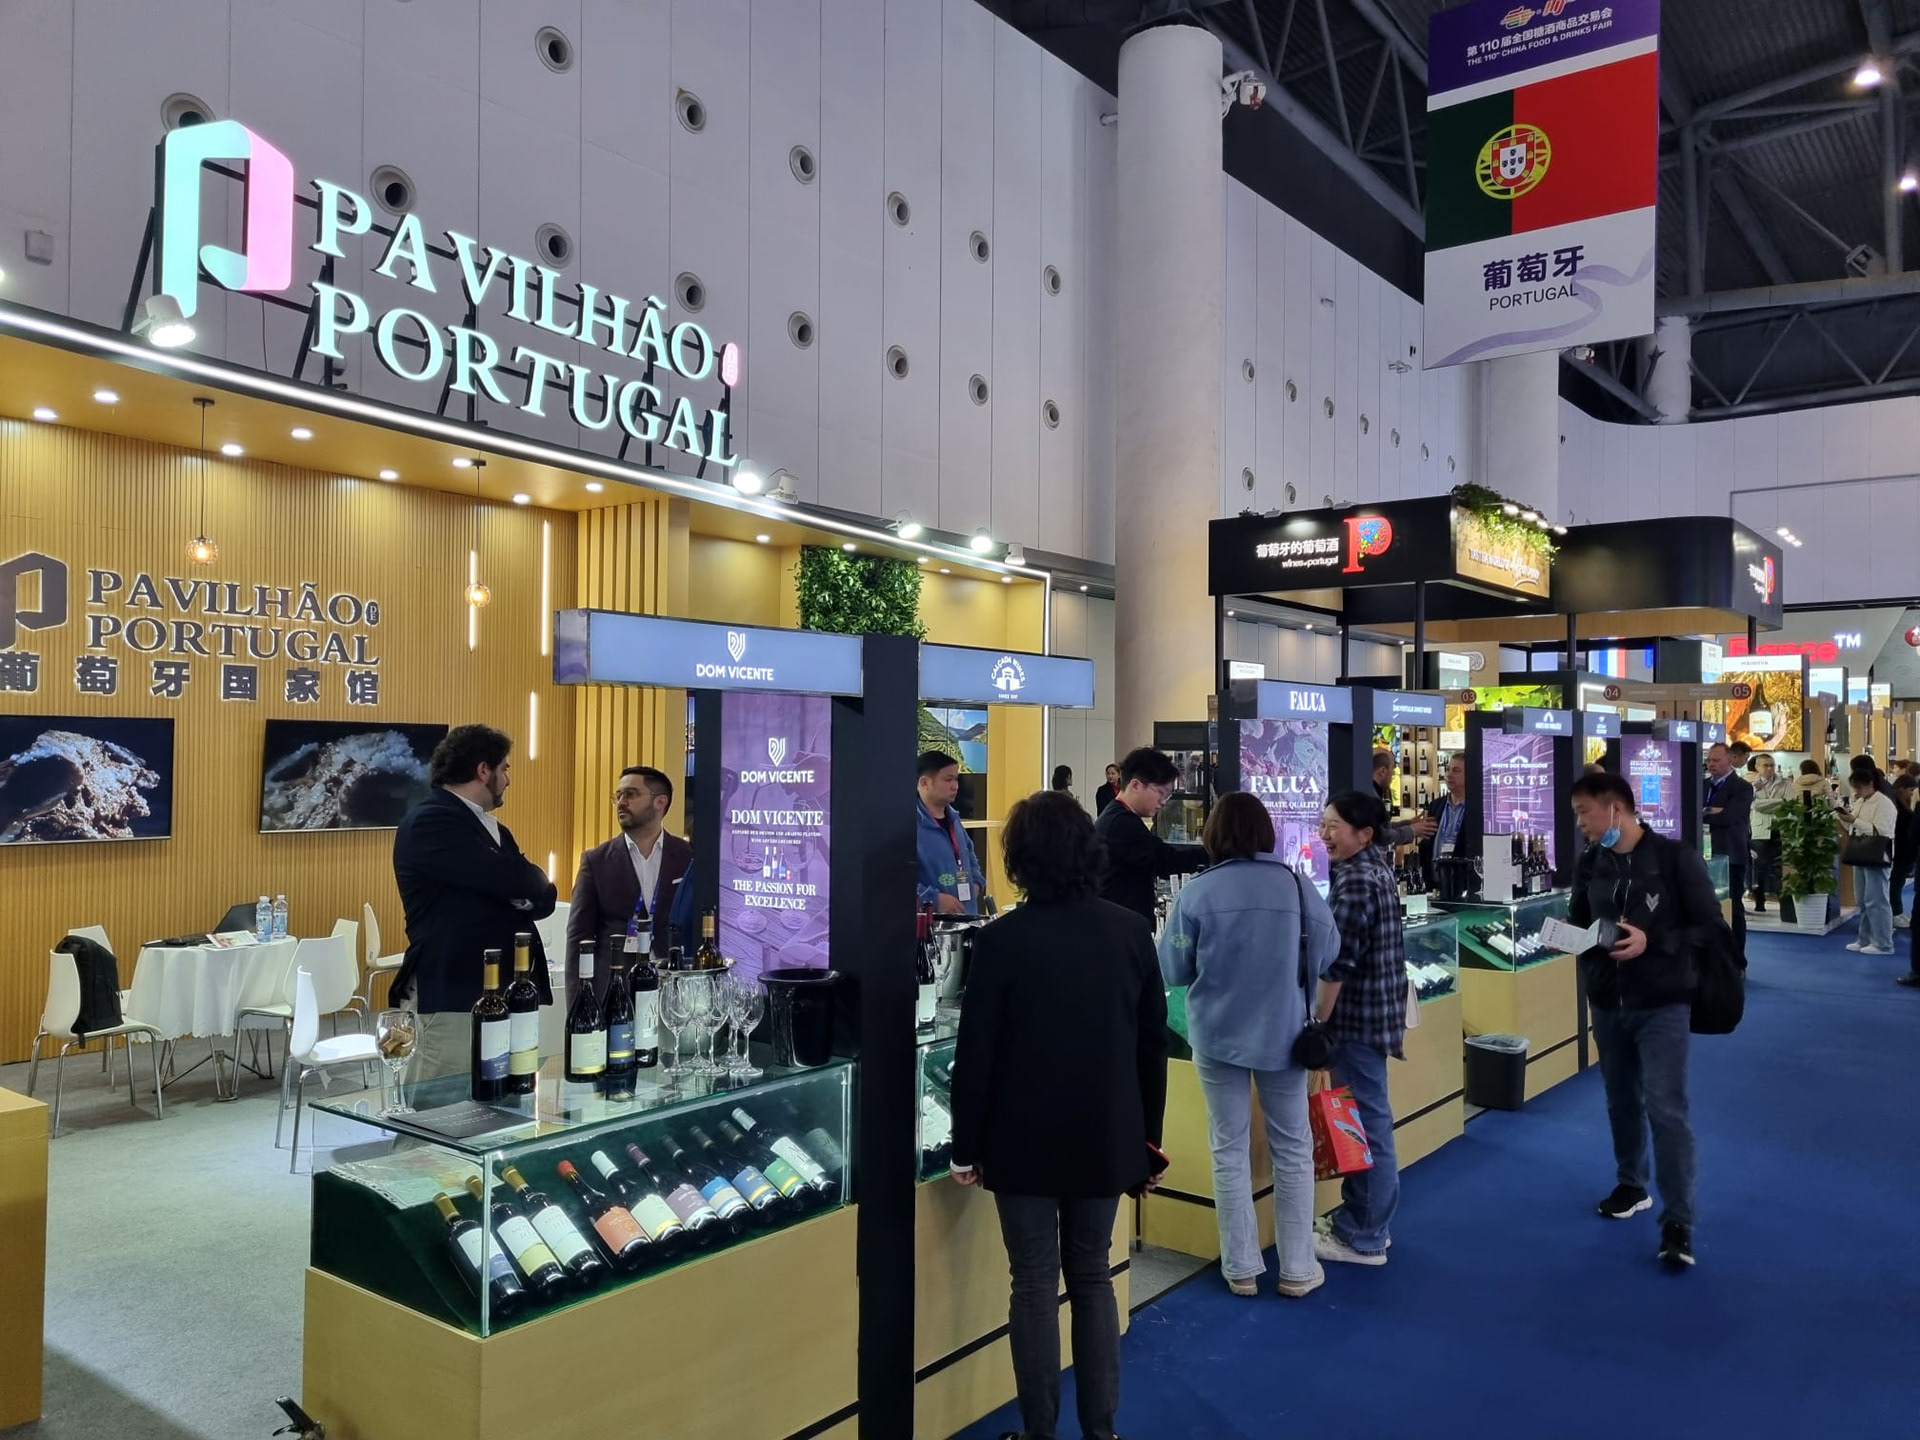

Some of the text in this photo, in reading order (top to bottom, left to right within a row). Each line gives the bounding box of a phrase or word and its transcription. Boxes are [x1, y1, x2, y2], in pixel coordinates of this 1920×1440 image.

[1467, 57, 1483, 67] THE
[1501, 45, 1528, 57] CHINA
[1528, 38, 1551, 50] FOOD
[1552, 35, 1559, 43] &
[1560, 26, 1592, 41] DRINKS
[1592, 20, 1613, 31] FAIR
[1482, 245, 1585, 292] 葡萄牙
[310, 179, 714, 381] PAVILHÃO
[1489, 283, 1579, 311] PORTUGAL
[310, 281, 738, 467] PORTUGAL
[1256, 537, 1340, 558] 葡萄牙的葡萄酒
[88, 569, 363, 626] PAVILHÃO
[87, 614, 380, 666] PORTUGAL
[1833, 632, 1862, 648] TM
[696, 664, 775, 681] DOM VICENTE
[1462, 692, 1475, 701] 03
[1604, 688, 1619, 698] 04
[1733, 687, 1750, 697] 05
[1290, 691, 1327, 712] FALUA
[741, 770, 815, 783] DOM VICENTE
[1250, 775, 1321, 794] FALUA
[1491, 774, 1549, 786] MONTE
[1288, 801, 1319, 810] QUALITY
[731, 809, 824, 826] DOM VICENTE
[733, 880, 816, 896] THE PASSION FOR
[745, 895, 806, 910] EXCELLENCE
